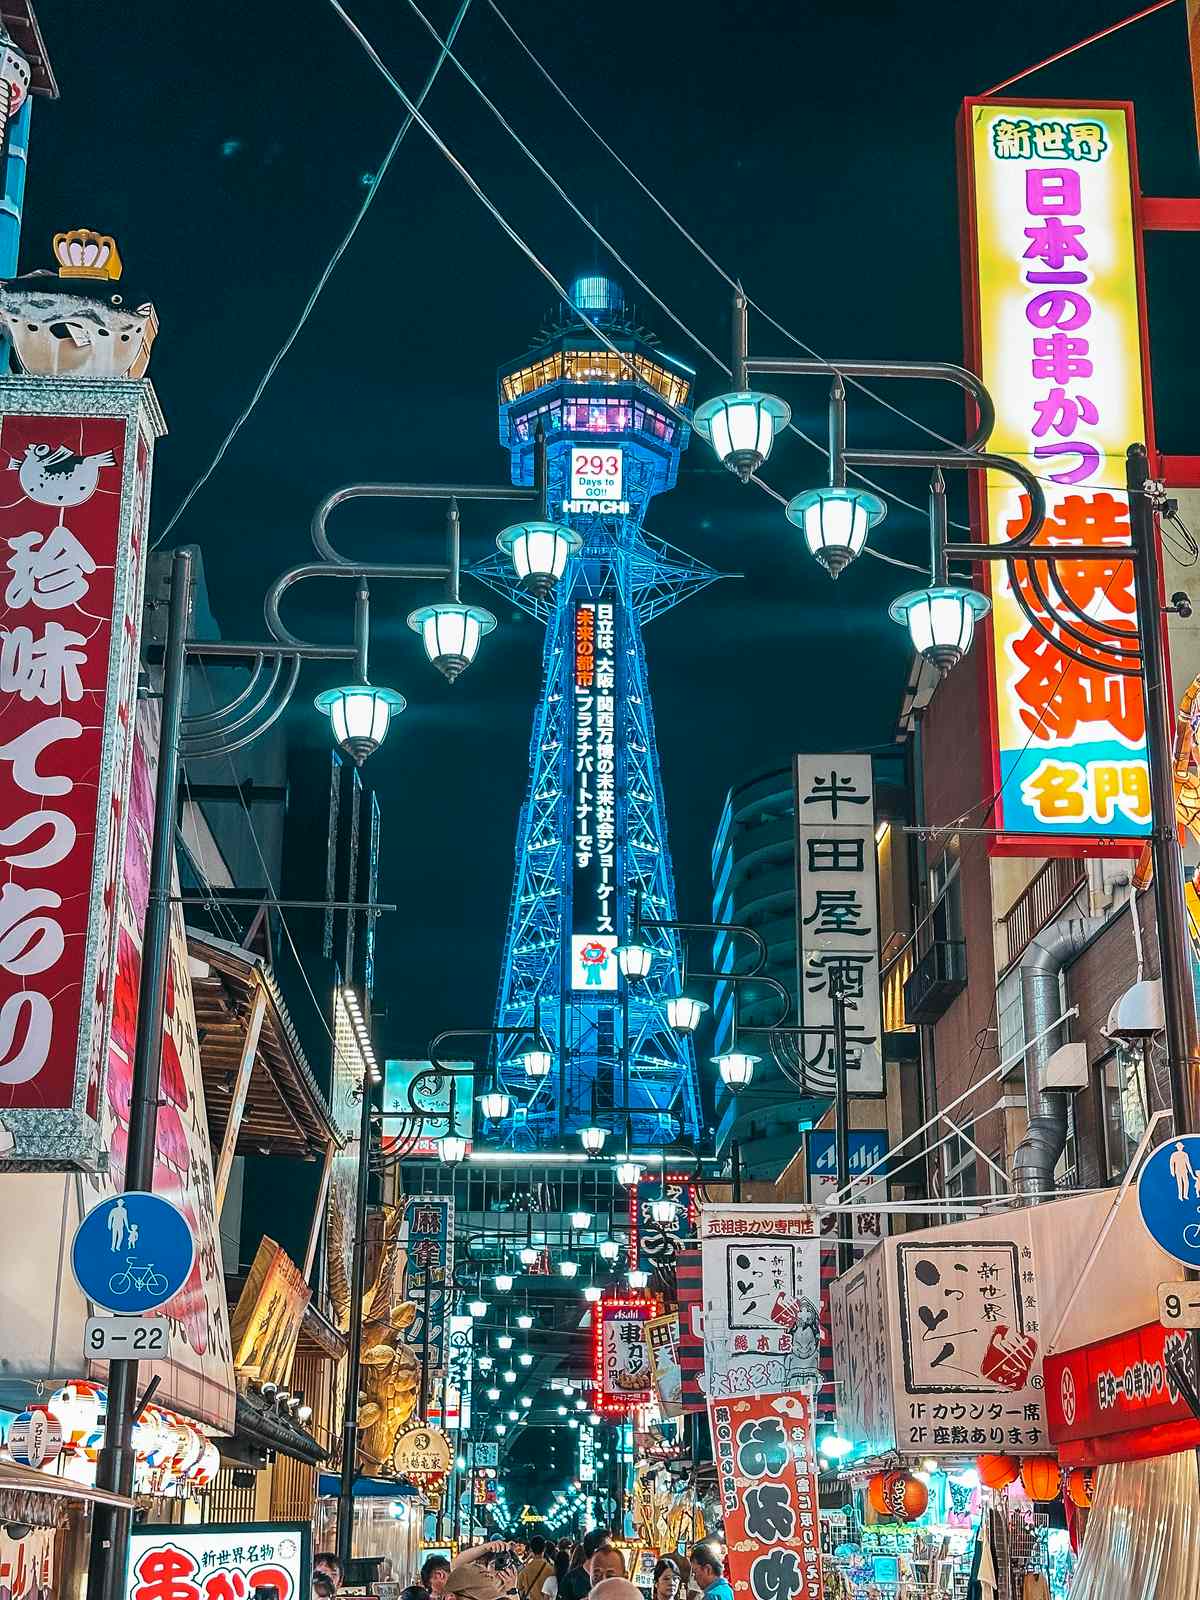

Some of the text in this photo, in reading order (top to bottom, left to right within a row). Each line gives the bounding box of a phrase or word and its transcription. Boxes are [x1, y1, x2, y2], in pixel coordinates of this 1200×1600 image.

[992, 119, 1107, 162] 新世界
[1022, 168, 1101, 485] 日本一の串かつ
[575, 455, 618, 476] 293
[579, 477, 615, 488] Days to
[562, 499, 630, 515] HITACHI
[586, 487, 607, 498] GO!!
[1005, 492, 1147, 742] 横綱
[574, 603, 596, 868] 「未来の都市」プラチナパートナーです
[596, 603, 616, 933] 日立は、大阪・関西万博の未来社会ショーケース
[1024, 762, 1153, 822] 名門
[802, 770, 877, 1072] 半田屋酒店
[816, 1143, 880, 1170] Aahi
[410, 1203, 443, 1267] 麻雀
[707, 1218, 815, 1236] 元祖串カツ専門店
[977, 1262, 1008, 1322] 新世界
[1021, 1247, 1040, 1333] 商標登録
[613, 1310, 639, 1320] Asahi
[619, 1322, 643, 1375] 串カツ
[1097, 1360, 1164, 1411] 日本一の串かつ
[909, 1402, 1041, 1422] 1F カウンター席
[910, 1425, 1043, 1446] 2F 座敷あります
[201, 1543, 275, 1568] 新世界名物
